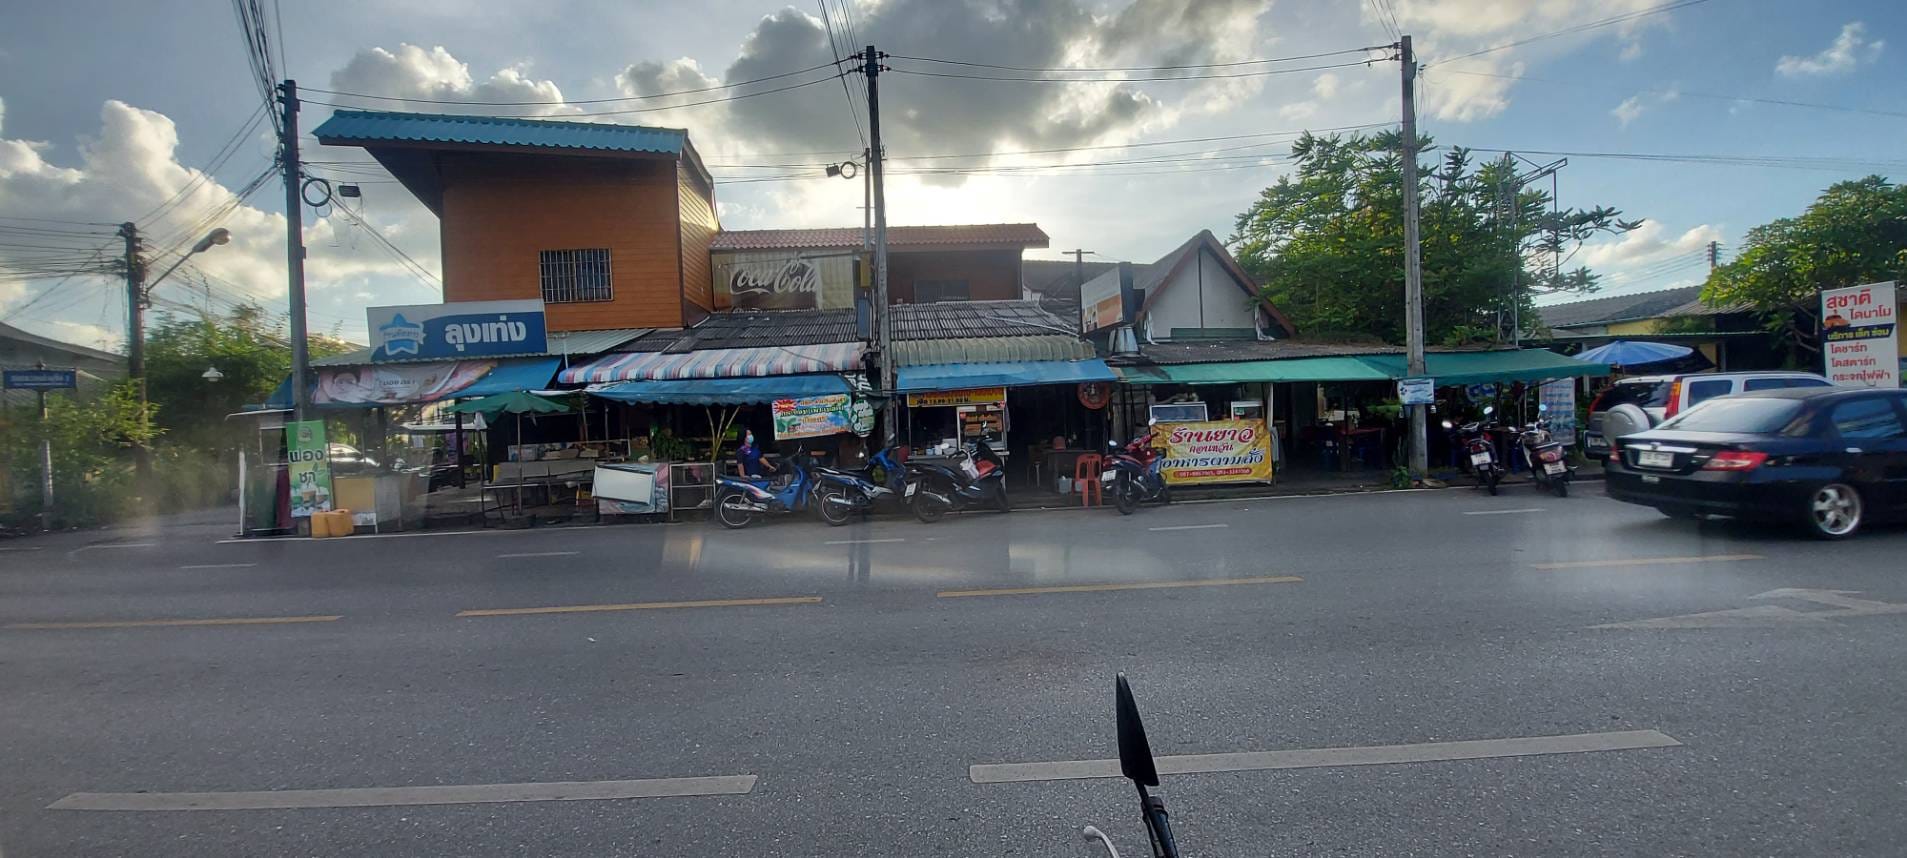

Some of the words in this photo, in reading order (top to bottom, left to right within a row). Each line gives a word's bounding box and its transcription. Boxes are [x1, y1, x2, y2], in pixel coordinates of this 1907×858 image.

[1826, 288, 1871, 314] สุชาติ
[445, 315, 526, 351] ลุงเท่ง
[1827, 330, 1854, 340] บริการ
[1163, 448, 1263, 468] อาหารตามสั่ง
